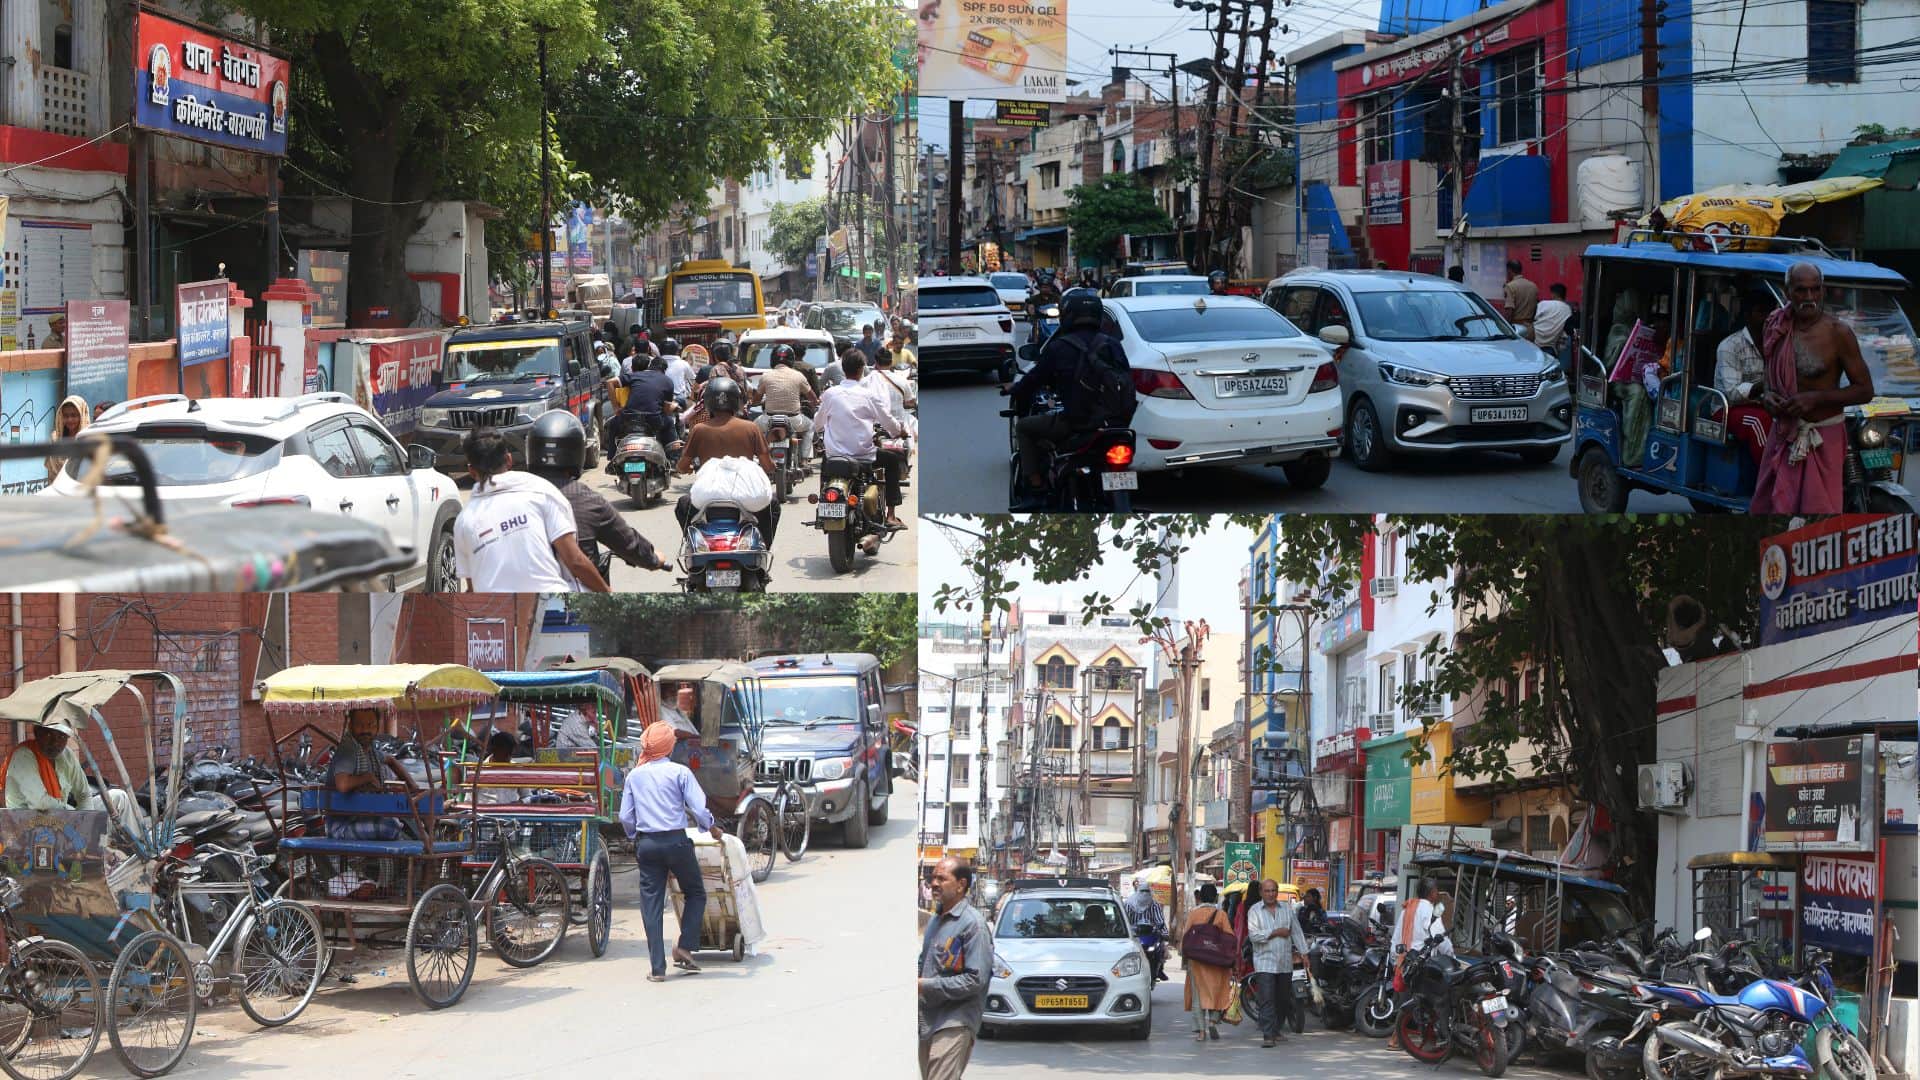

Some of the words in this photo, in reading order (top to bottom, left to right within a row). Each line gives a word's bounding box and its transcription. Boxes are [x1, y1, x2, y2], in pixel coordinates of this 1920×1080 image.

[963, 2, 986, 12] SPF
[989, 4, 1005, 13] 50
[1008, 5, 1035, 15] SUN
[1037, 6, 1059, 16] GEL
[185, 41, 213, 75] थाना
[223, 46, 260, 89] चेतगंज
[376, 361, 401, 396] थाना
[1224, 378, 1285, 392] UP65AZ4452
[500, 513, 528, 532] BHU
[1791, 531, 1842, 577] थाना
[1846, 513, 1913, 566] लक्सा
[1804, 856, 1836, 892] थाना
[1836, 859, 1876, 899] लक्सा
